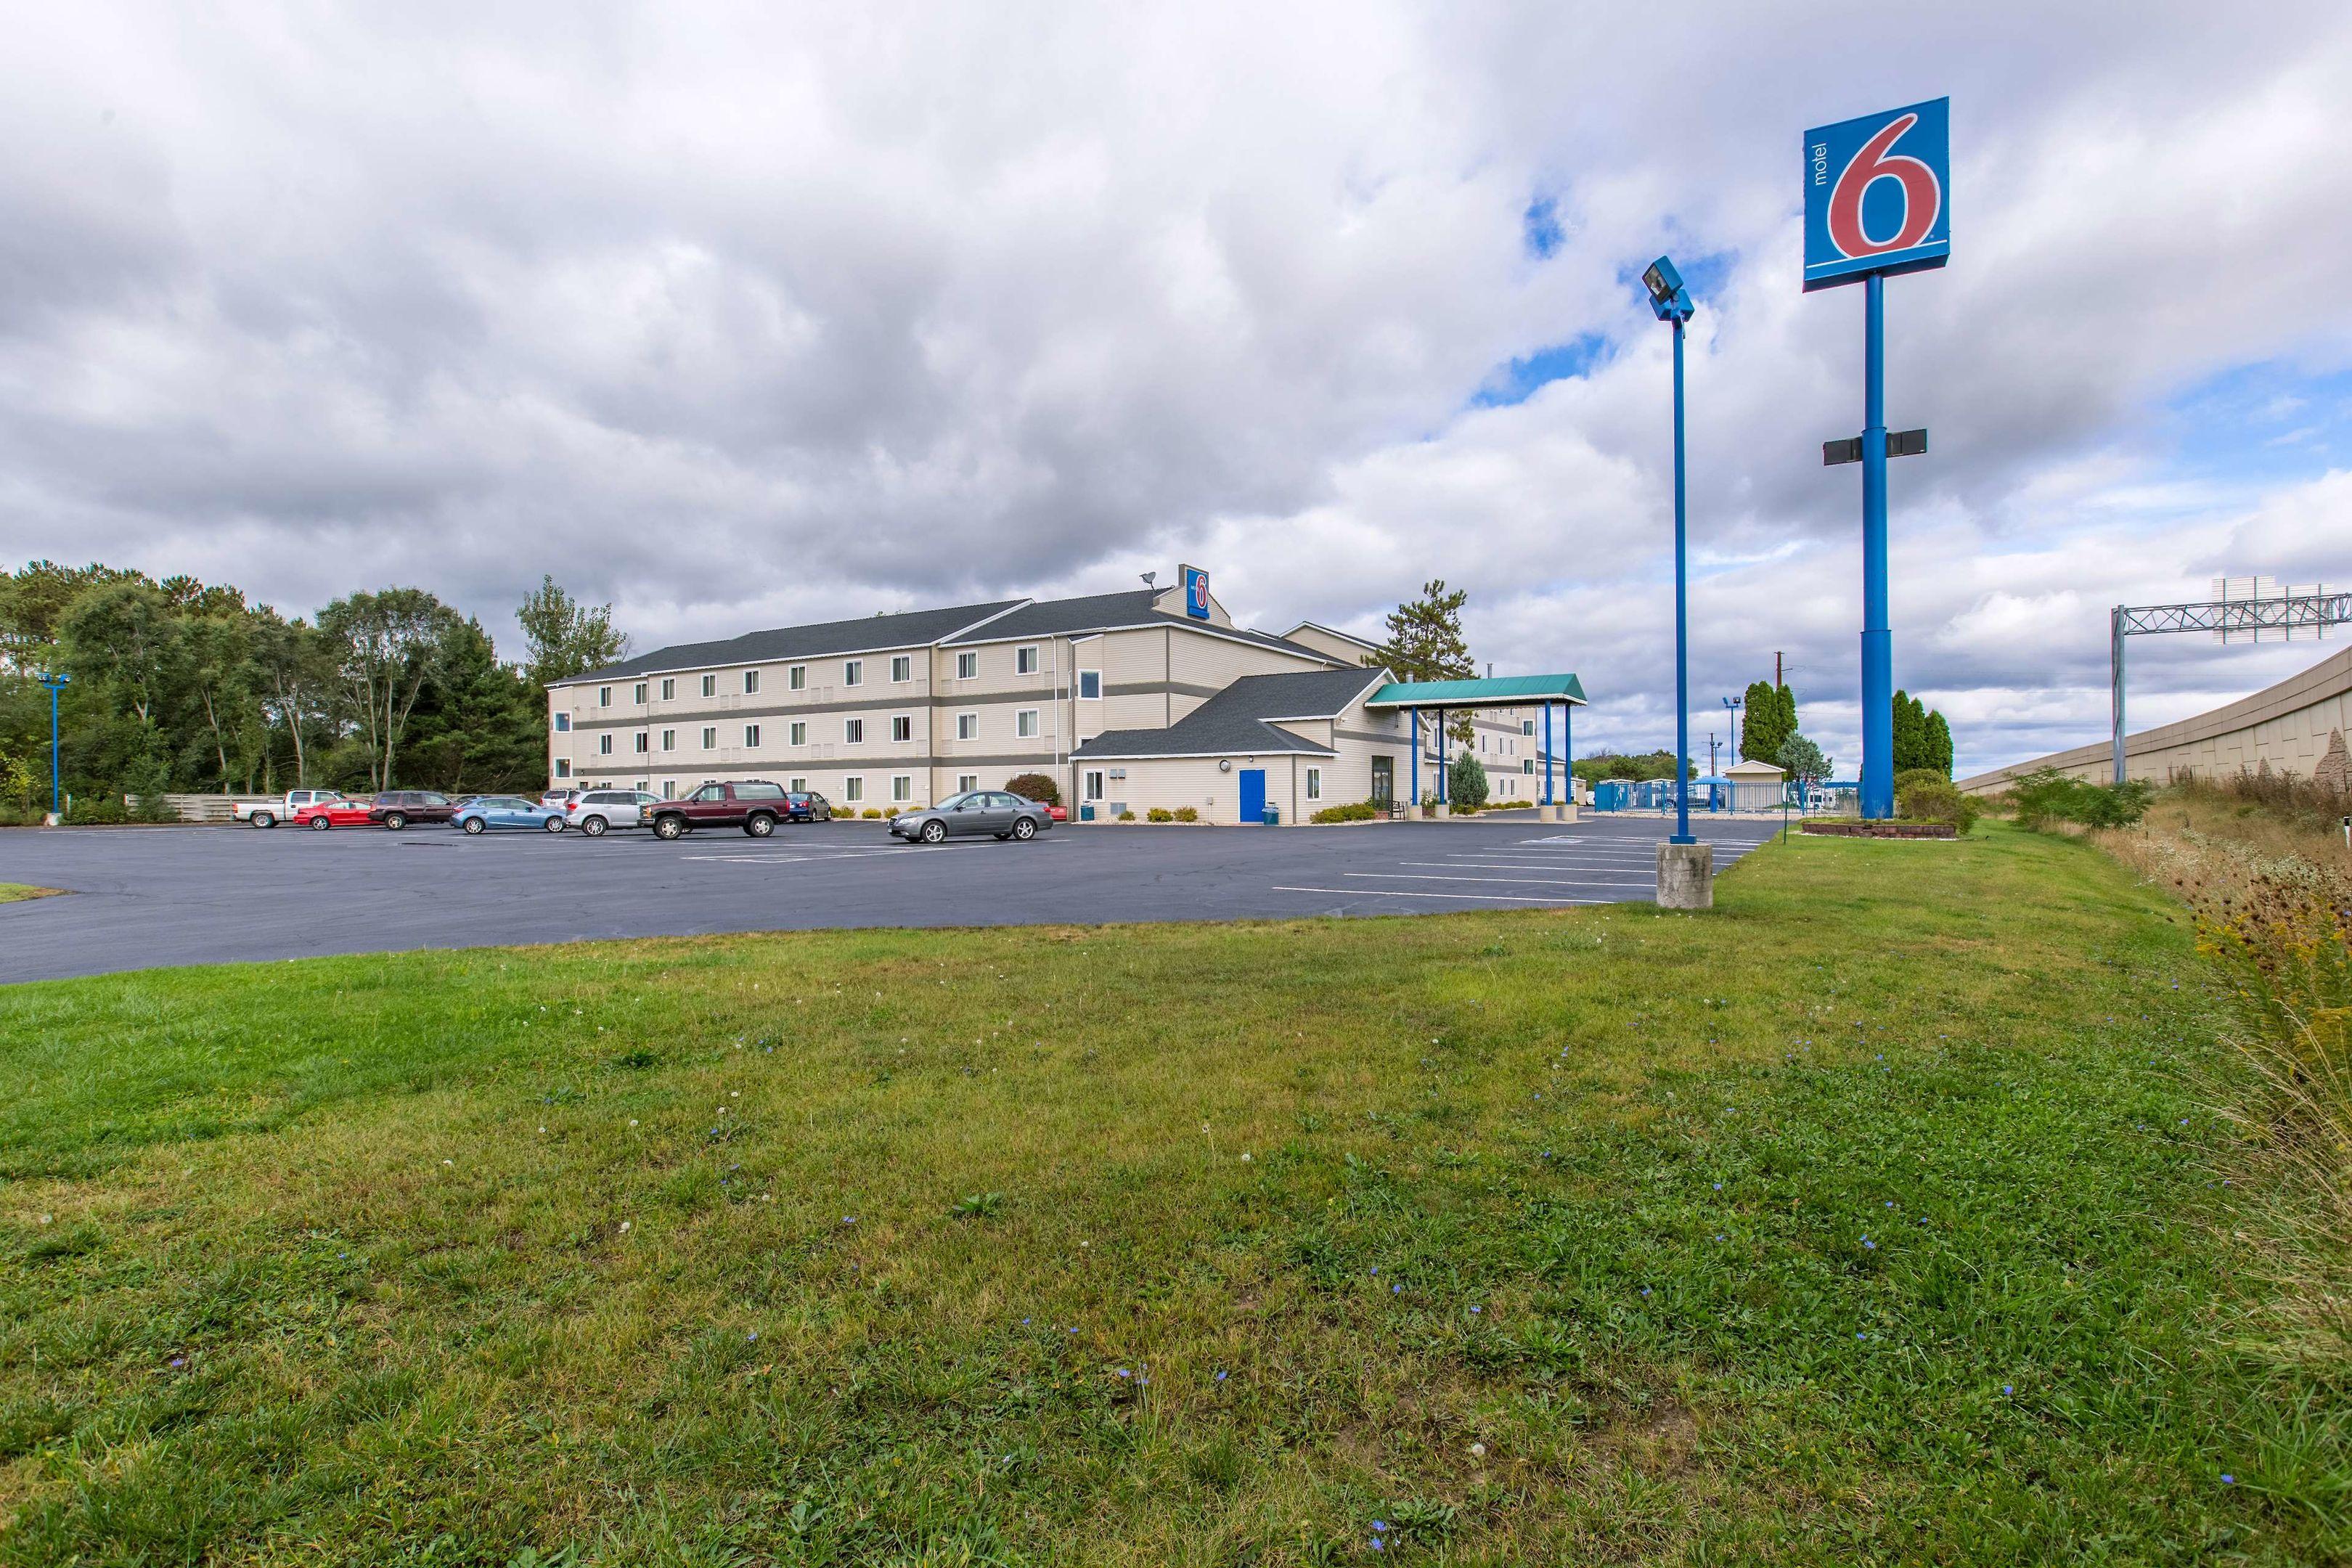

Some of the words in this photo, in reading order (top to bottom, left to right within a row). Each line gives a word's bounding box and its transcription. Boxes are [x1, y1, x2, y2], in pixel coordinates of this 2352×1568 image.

[1812, 143, 1826, 186] motel
[1827, 113, 1941, 259] 6
[1196, 574, 1207, 608] 6
